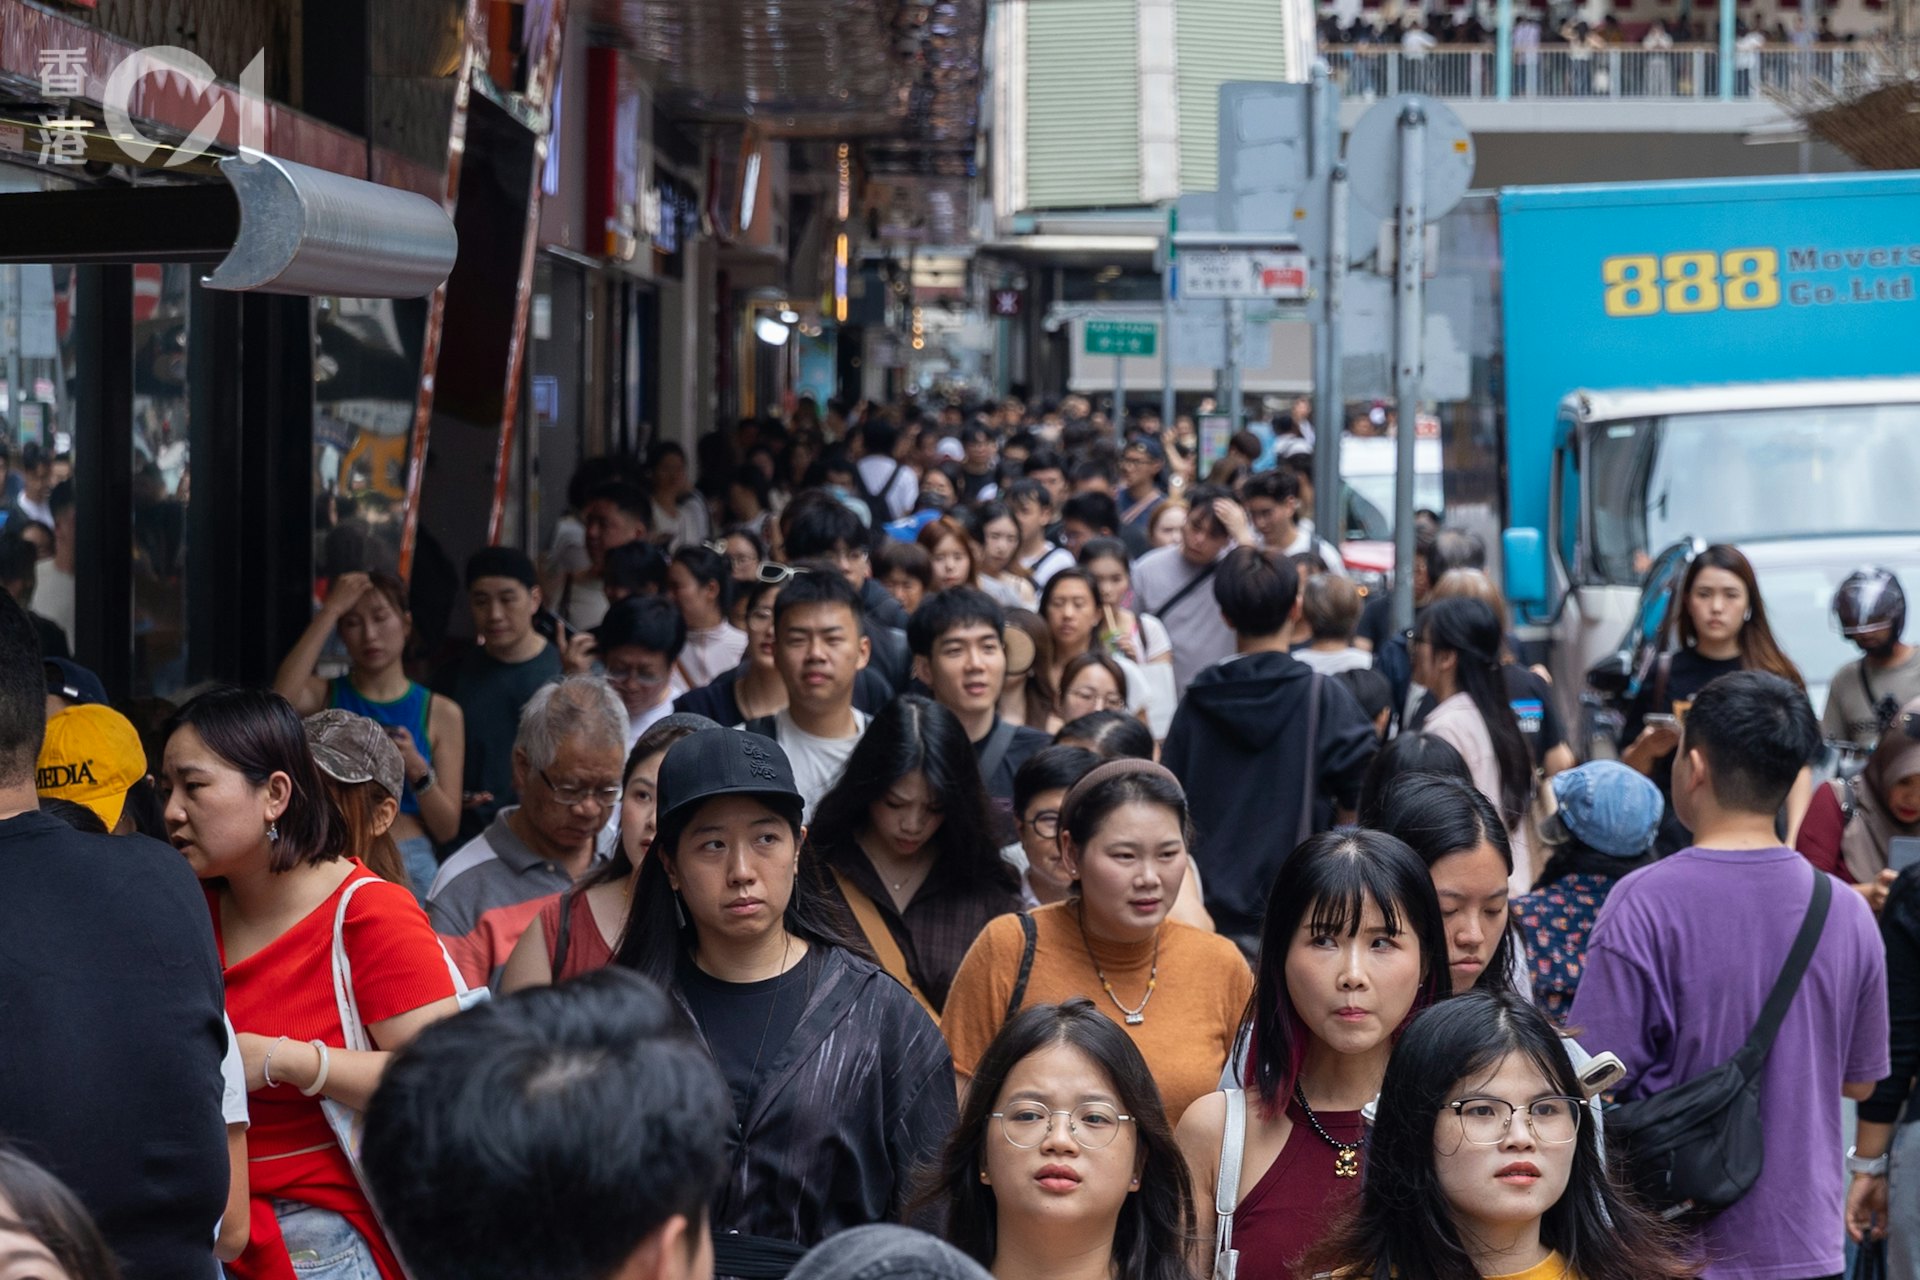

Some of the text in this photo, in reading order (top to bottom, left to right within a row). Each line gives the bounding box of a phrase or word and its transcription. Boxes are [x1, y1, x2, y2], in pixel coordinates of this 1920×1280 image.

[1787, 245, 1920, 273] Movers
[1602, 246, 1781, 318] 888
[1788, 276, 1912, 307] Co.Ltd
